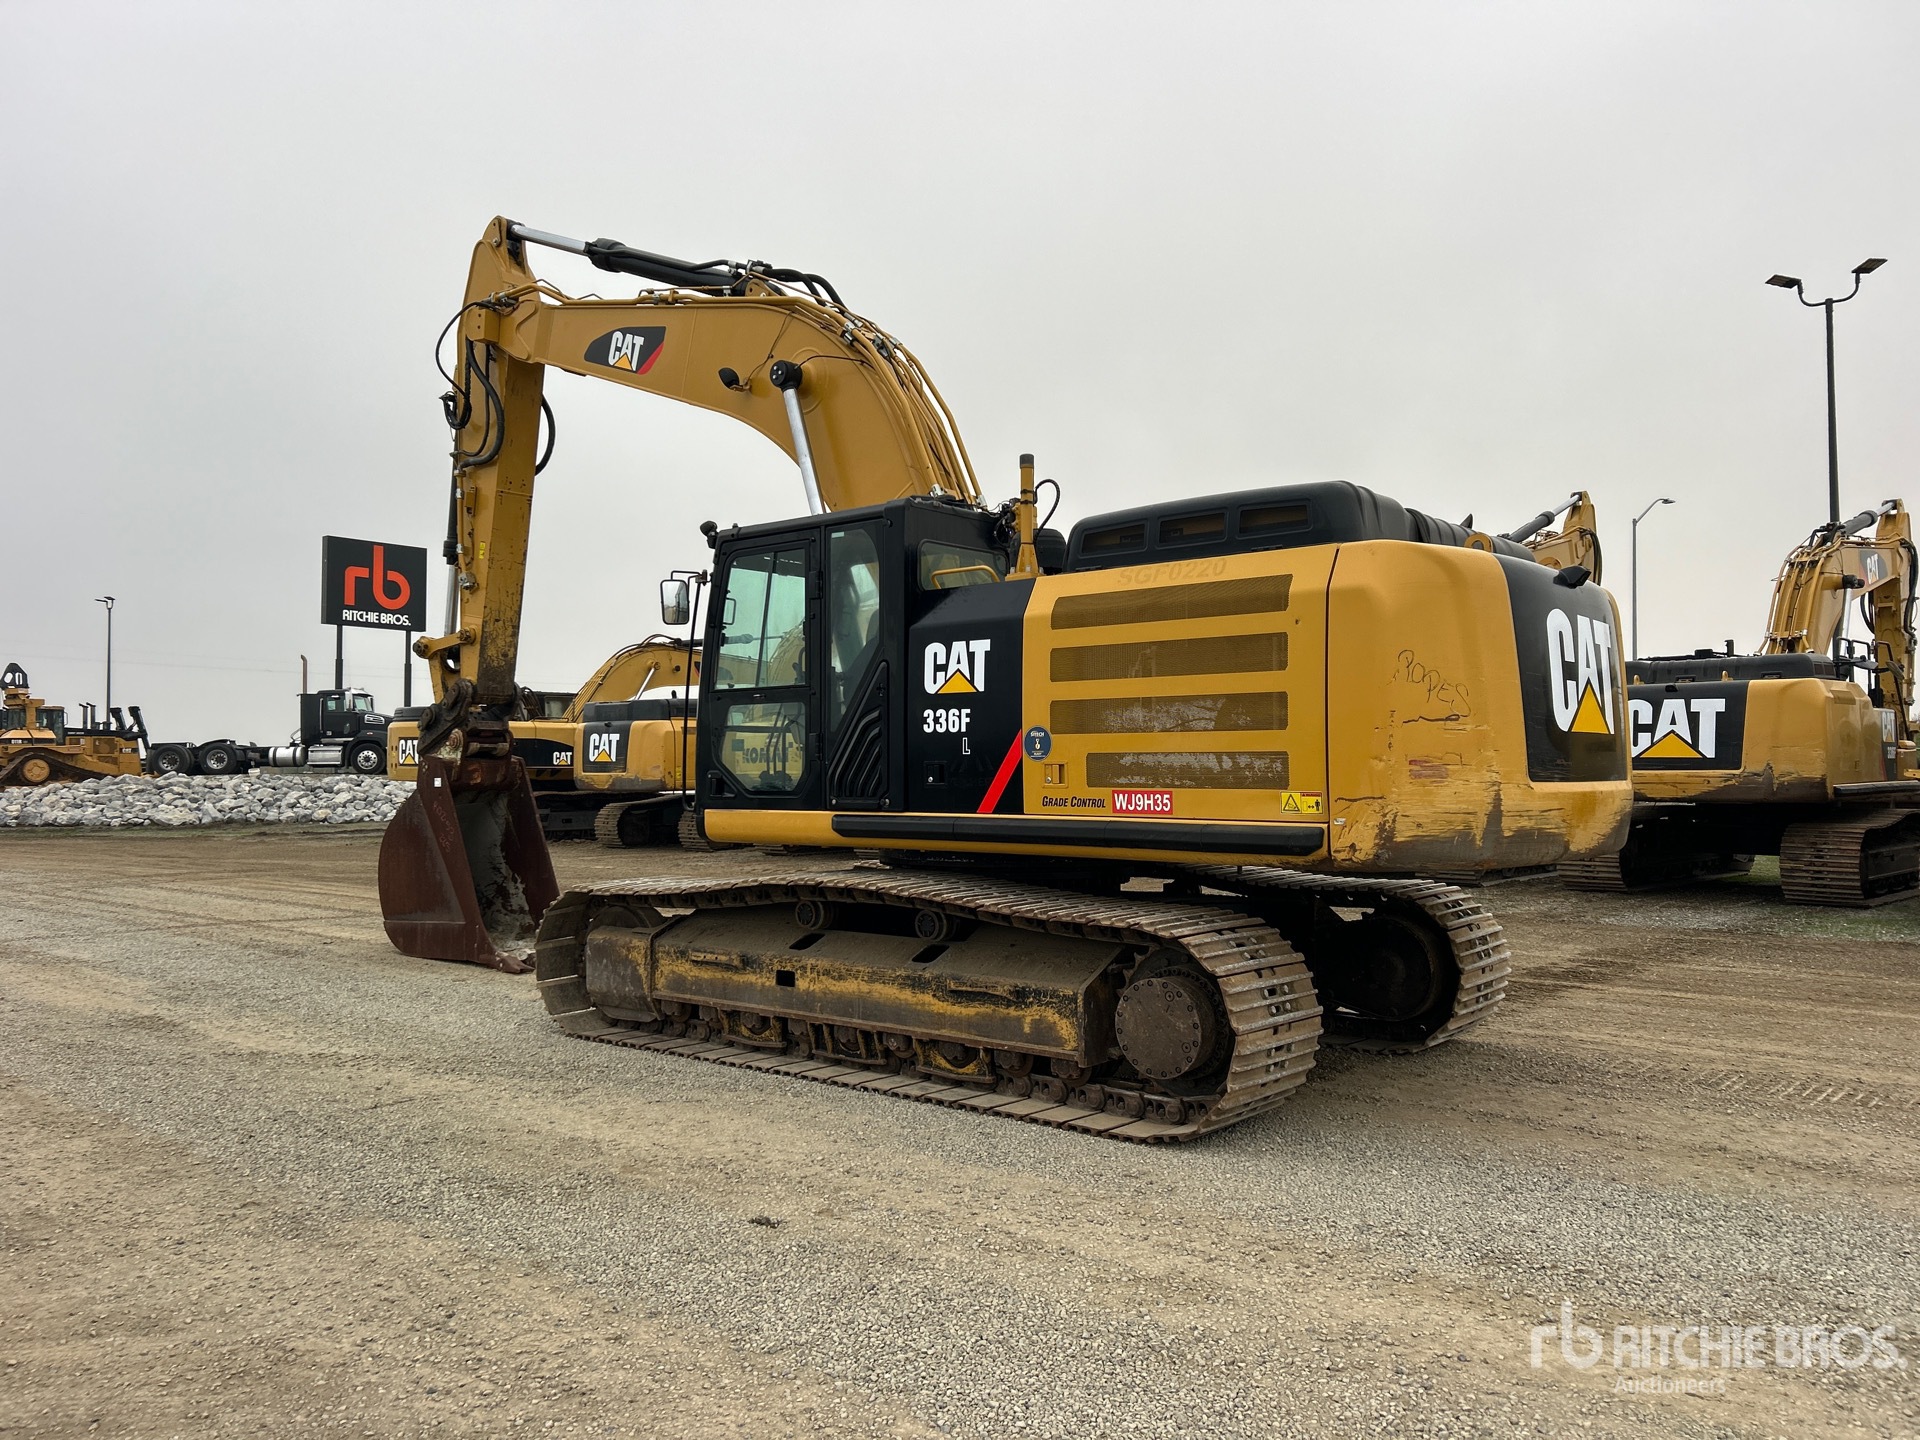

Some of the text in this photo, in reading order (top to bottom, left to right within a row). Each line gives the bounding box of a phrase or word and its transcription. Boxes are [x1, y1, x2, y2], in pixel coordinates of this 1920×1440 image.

[609, 331, 644, 372] CAT
[343, 545, 411, 610] rb
[1866, 553, 1879, 585] CAT
[342, 609, 411, 626] RITCHIE BROS.
[923, 638, 991, 695] CAT
[1546, 608, 1615, 736] CAT
[922, 708, 971, 734] 336F
[1631, 698, 1726, 759] CAT
[552, 751, 572, 765] CAT
[588, 733, 620, 762] CAT
[962, 737, 971, 756] L
[1042, 795, 1106, 808] GRADE CONTROL
[1114, 793, 1171, 811] WJ9H35
